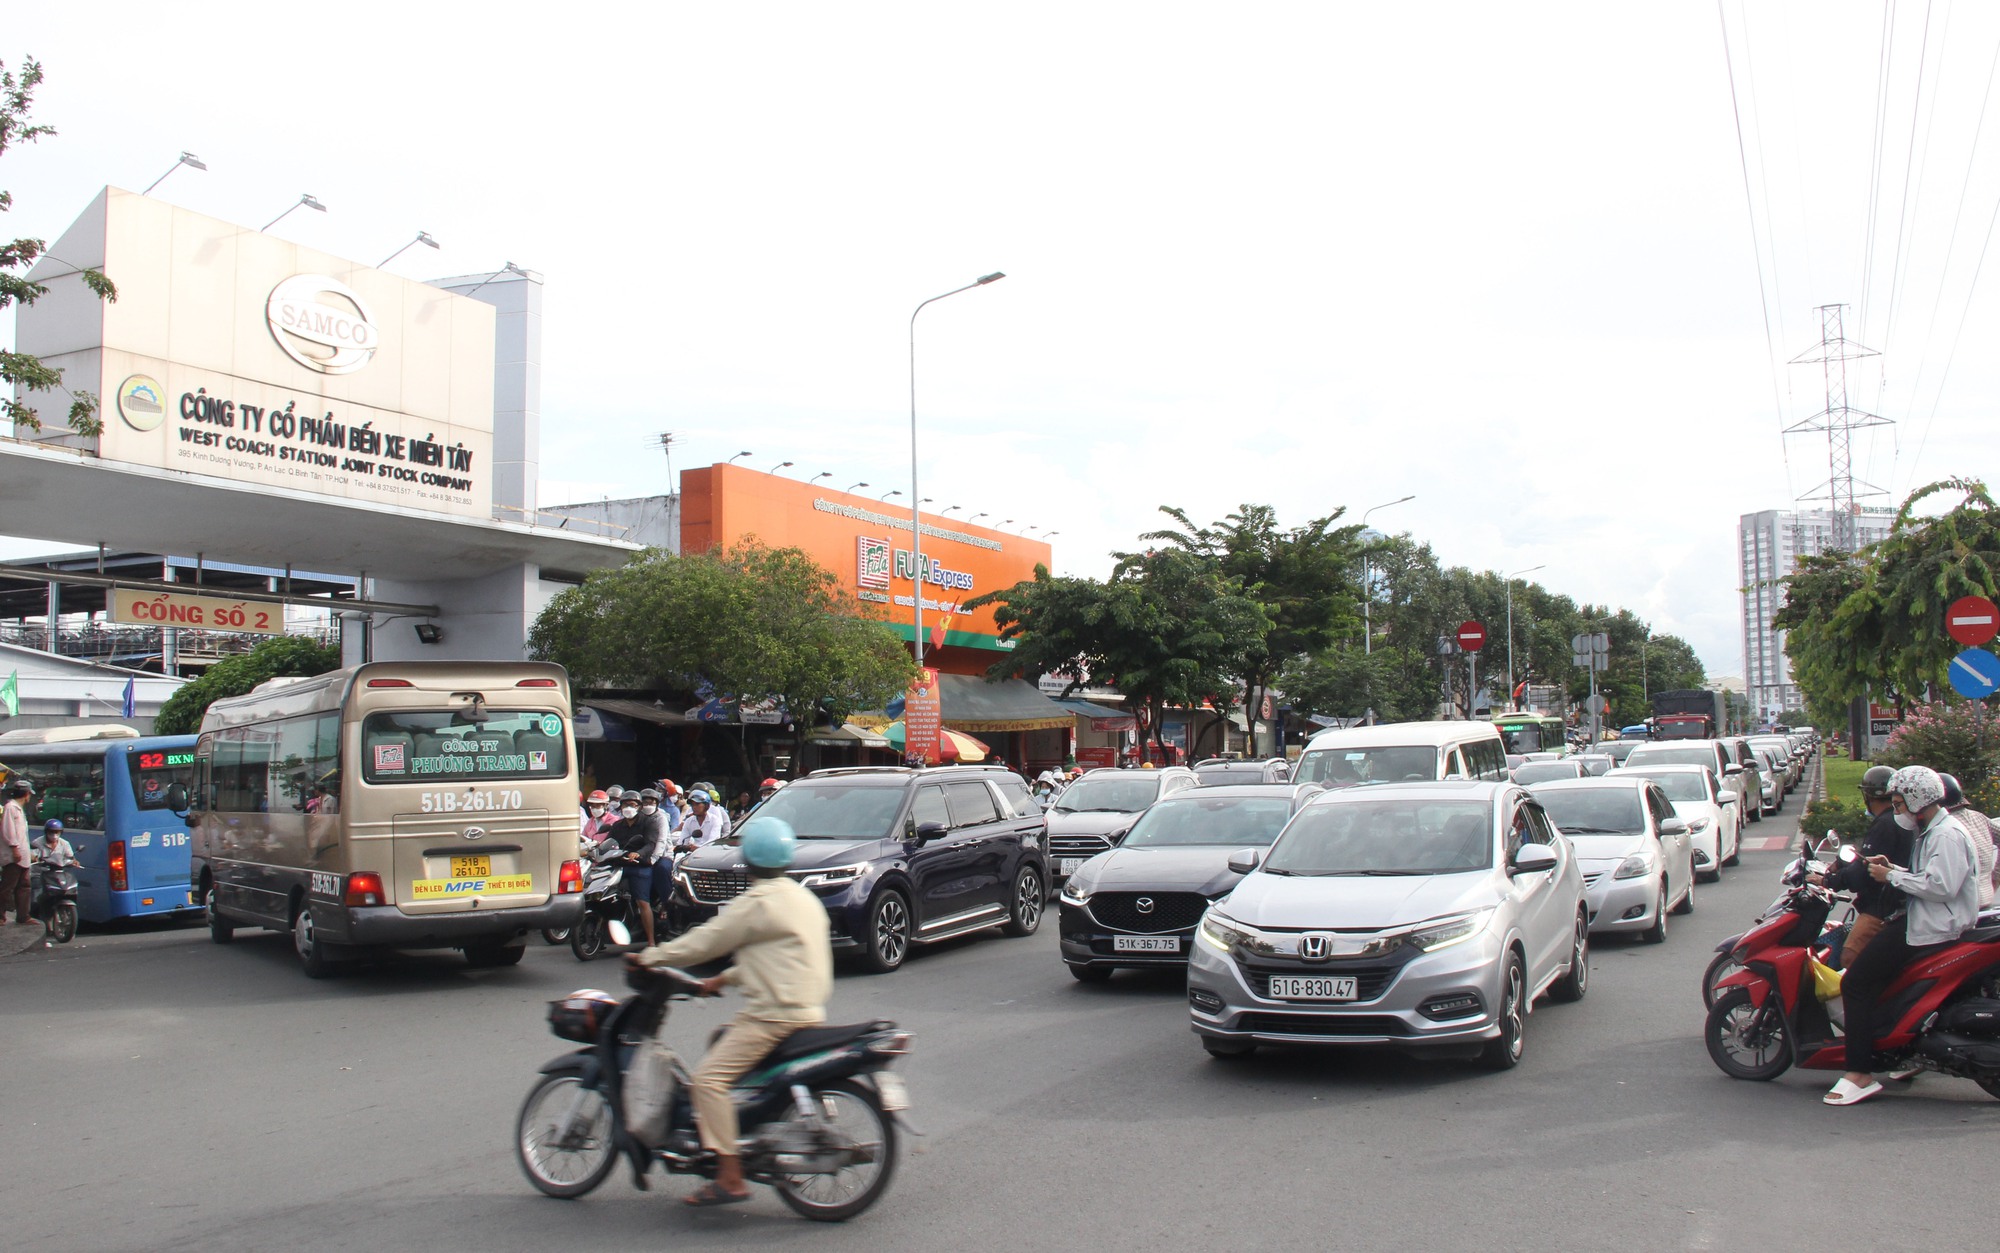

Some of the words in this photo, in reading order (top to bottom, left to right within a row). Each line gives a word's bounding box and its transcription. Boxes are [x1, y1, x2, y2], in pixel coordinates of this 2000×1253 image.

[281, 304, 368, 345] SAMCO
[180, 387, 235, 428] CÔNG
[240, 403, 265, 433] TY
[270, 399, 296, 439] CỔ
[349, 421, 382, 456] BẾN
[384, 433, 406, 460] XE
[447, 442, 473, 472] TÂY
[178, 448, 191, 458] 395
[192, 450, 208, 461] Kinh
[179, 426, 222, 447] WEST
[225, 435, 275, 457] COACH
[279, 445, 337, 468] STATION
[341, 457, 375, 475] JOINT
[378, 464, 418, 483] STOCK
[420, 471, 473, 492] COMPANY
[932, 559, 974, 590] Express
[131, 593, 204, 625] CỔNG
[213, 602, 248, 628] SỐ
[254, 612, 269, 630] 2
[545, 719, 558, 732] 27
[442, 738, 479, 753] CÔNG
[480, 740, 499, 752] TY
[139, 753, 164, 769] 32
[411, 755, 474, 774] PHƯƠNG
[476, 754, 527, 772] TRANG
[421, 790, 523, 812] 51B-261.70
[461, 857, 479, 867] 51B
[455, 866, 487, 877] 261.70
[444, 880, 485, 893] MPE
[488, 881, 506, 889] THIẾT
[515, 880, 531, 888] ĐIỆN
[1118, 938, 1175, 950] 51K-367.75
[1272, 979, 1354, 998] 51G-830.47
